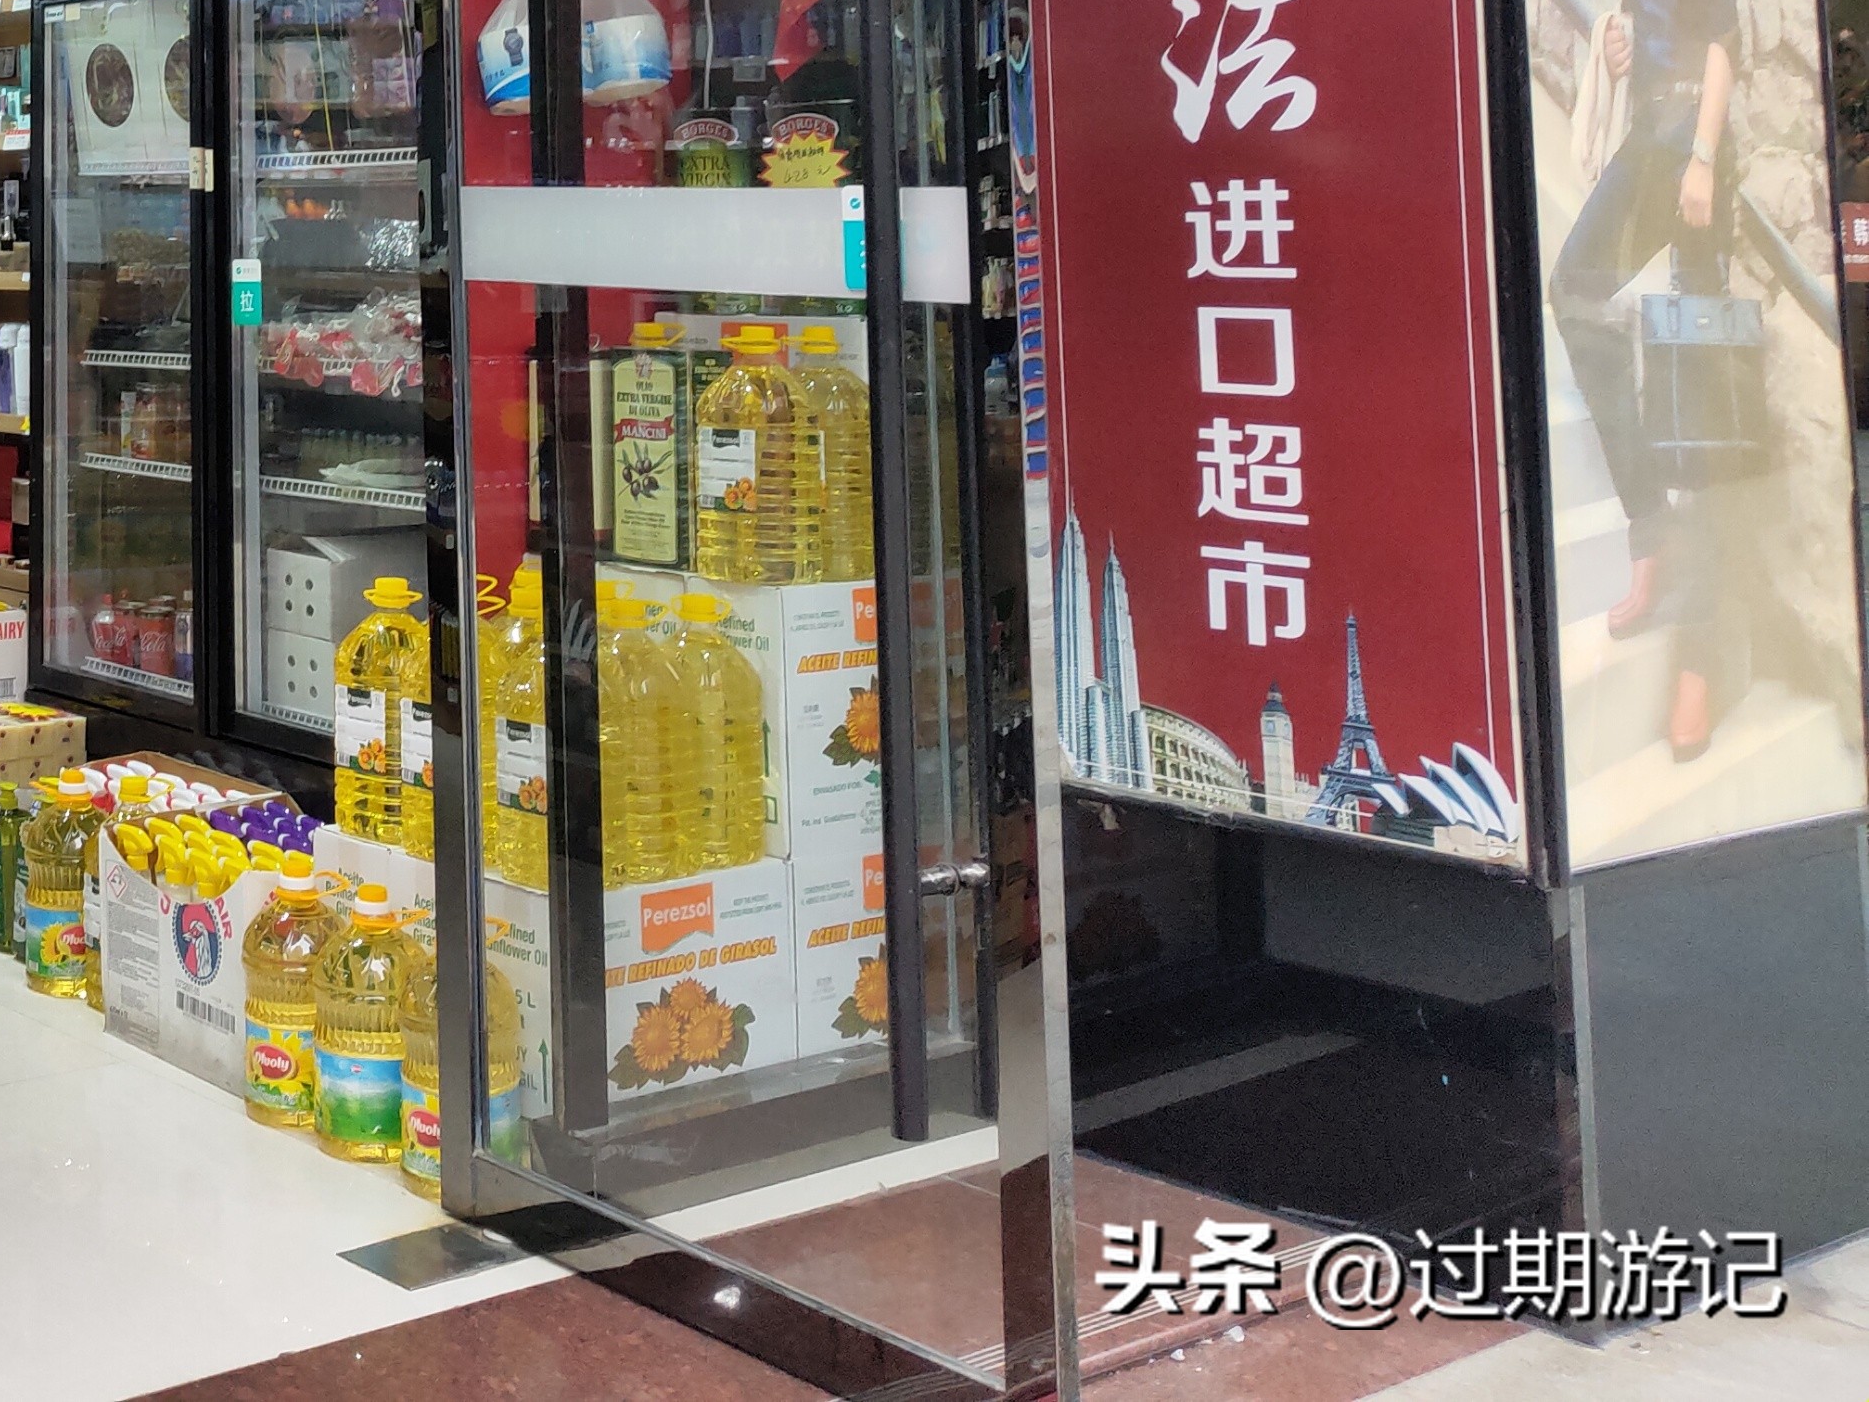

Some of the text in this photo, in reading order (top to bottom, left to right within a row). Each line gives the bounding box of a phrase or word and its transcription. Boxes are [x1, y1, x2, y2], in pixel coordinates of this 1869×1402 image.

[680, 121, 729, 140] BORGES
[779, 115, 828, 135] BORGES
[680, 155, 730, 171] EXTRA
[1185, 177, 1312, 648] 进口超市
[755, 635, 770, 652] Oil
[797, 652, 841, 674] ACEITE
[643, 897, 712, 927] Perezsol
[807, 923, 850, 948] ACEITE
[487, 939, 548, 968] unflower Oil
[628, 951, 697, 984] REFINADO
[699, 947, 717, 968] DE
[719, 936, 778, 965] GIRASOL
